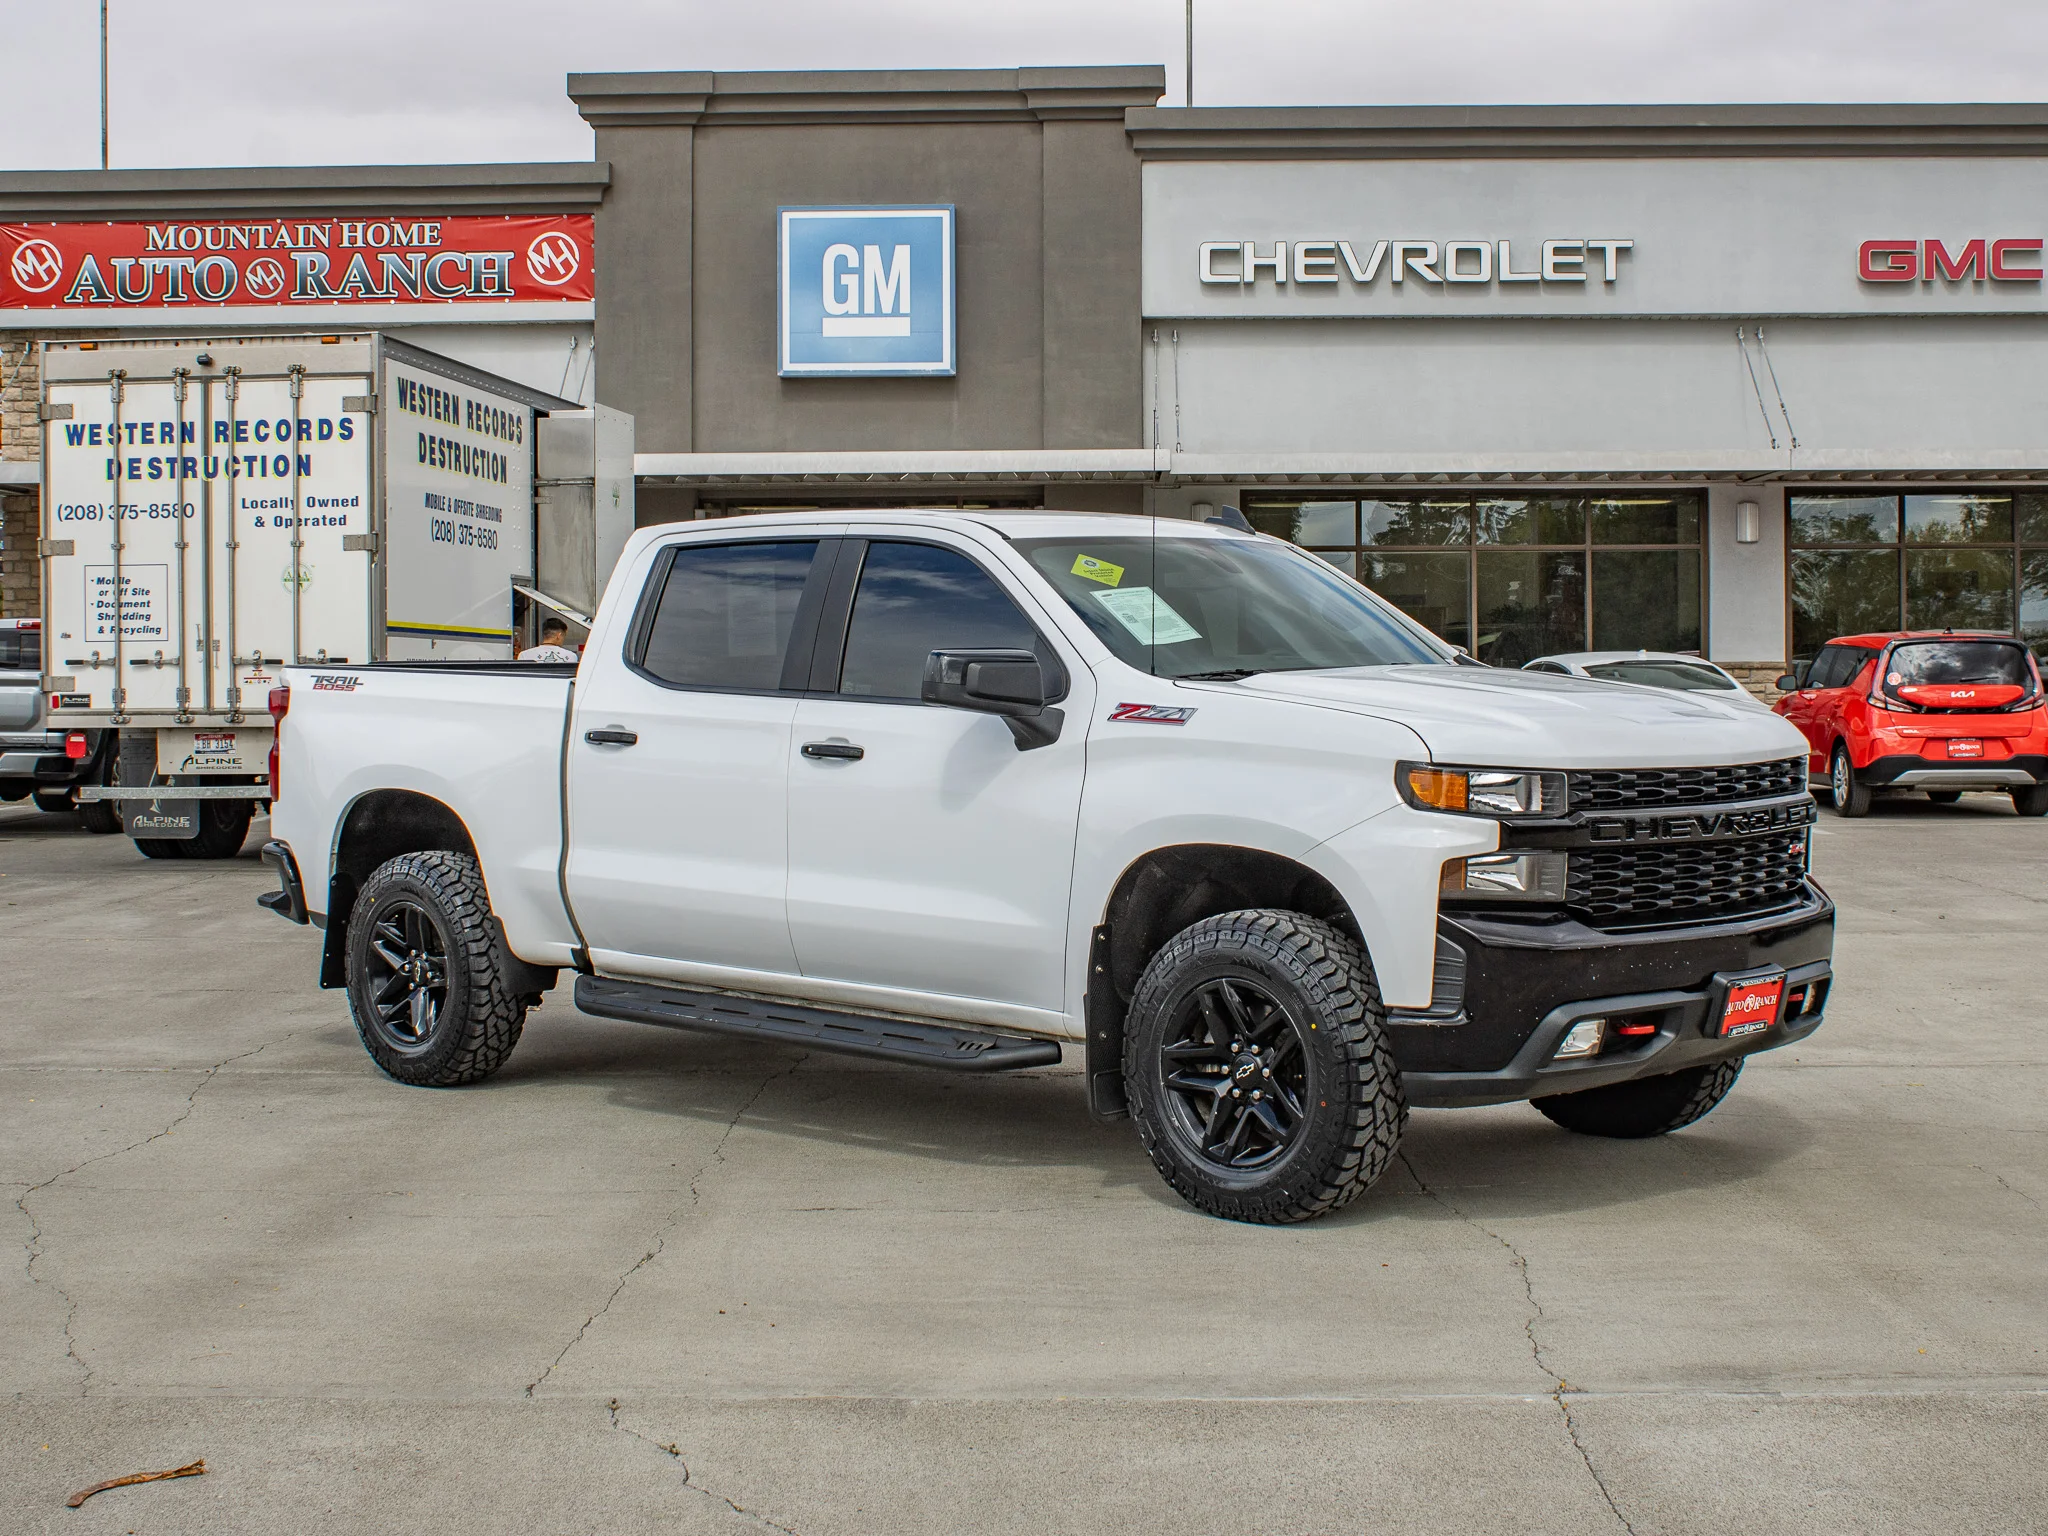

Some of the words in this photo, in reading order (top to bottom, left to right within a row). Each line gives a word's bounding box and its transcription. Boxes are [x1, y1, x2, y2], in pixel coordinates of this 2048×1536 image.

[145, 223, 331, 251] MOUNTAIN
[338, 222, 442, 249] HOME
[1199, 239, 1635, 283] CHEVROLET
[1857, 238, 2043, 281] GMC
[63, 253, 239, 303] AUTO
[289, 251, 515, 300] RANCH
[822, 243, 911, 316] GM
[397, 377, 460, 427] WESTERN
[466, 399, 523, 445] RECORDS
[65, 421, 195, 446] WESTERN
[213, 417, 354, 443] RECORDS
[106, 454, 312, 481] DESTRUCTION
[418, 432, 507, 485] DESTRUCTION
[57, 503, 104, 522] (208)
[306, 496, 359, 508] Owned
[424, 492, 446, 512] MOBILE
[447, 497, 452, 512] &
[453, 498, 474, 517] OFFSITE
[254, 516, 265, 527] &
[273, 514, 347, 528] Operated
[431, 516, 455, 545] (208)
[458, 523, 498, 550] 375-8580
[131, 587, 151, 596] Site
[97, 612, 152, 621] Shrdding
[98, 626, 105, 634] &
[310, 675, 364, 685] TRAIL
[313, 684, 356, 692] BOSS
[1107, 702, 1198, 726] Z71
[182, 755, 243, 768] ALPINE
[133, 815, 190, 825] ALPINE
[1589, 801, 1815, 843] CHEVROLET
[1724, 1000, 1745, 1016] AUTO
[1753, 994, 1778, 1011] RANCH
